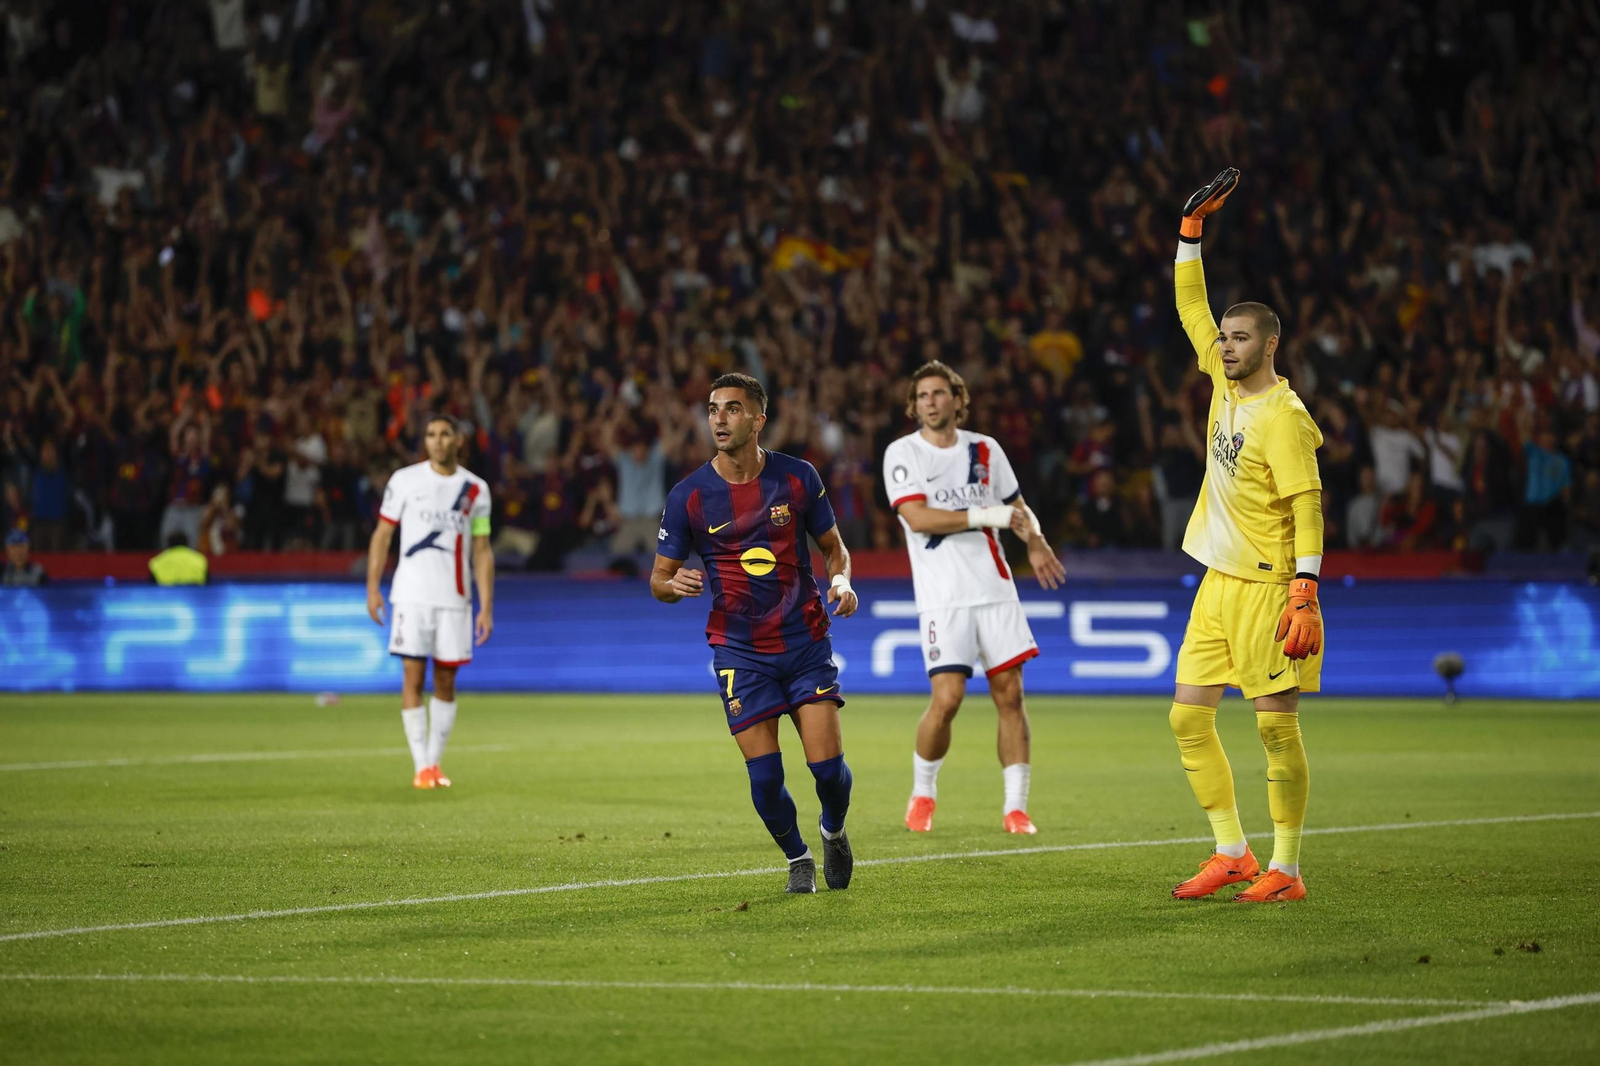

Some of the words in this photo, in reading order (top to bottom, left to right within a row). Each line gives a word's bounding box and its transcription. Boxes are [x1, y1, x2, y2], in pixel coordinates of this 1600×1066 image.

[1212, 420, 1238, 466] QATAR
[935, 484, 986, 502] QATAR
[105, 603, 384, 675] PS5
[929, 620, 936, 644] 6
[719, 669, 735, 698] 7
